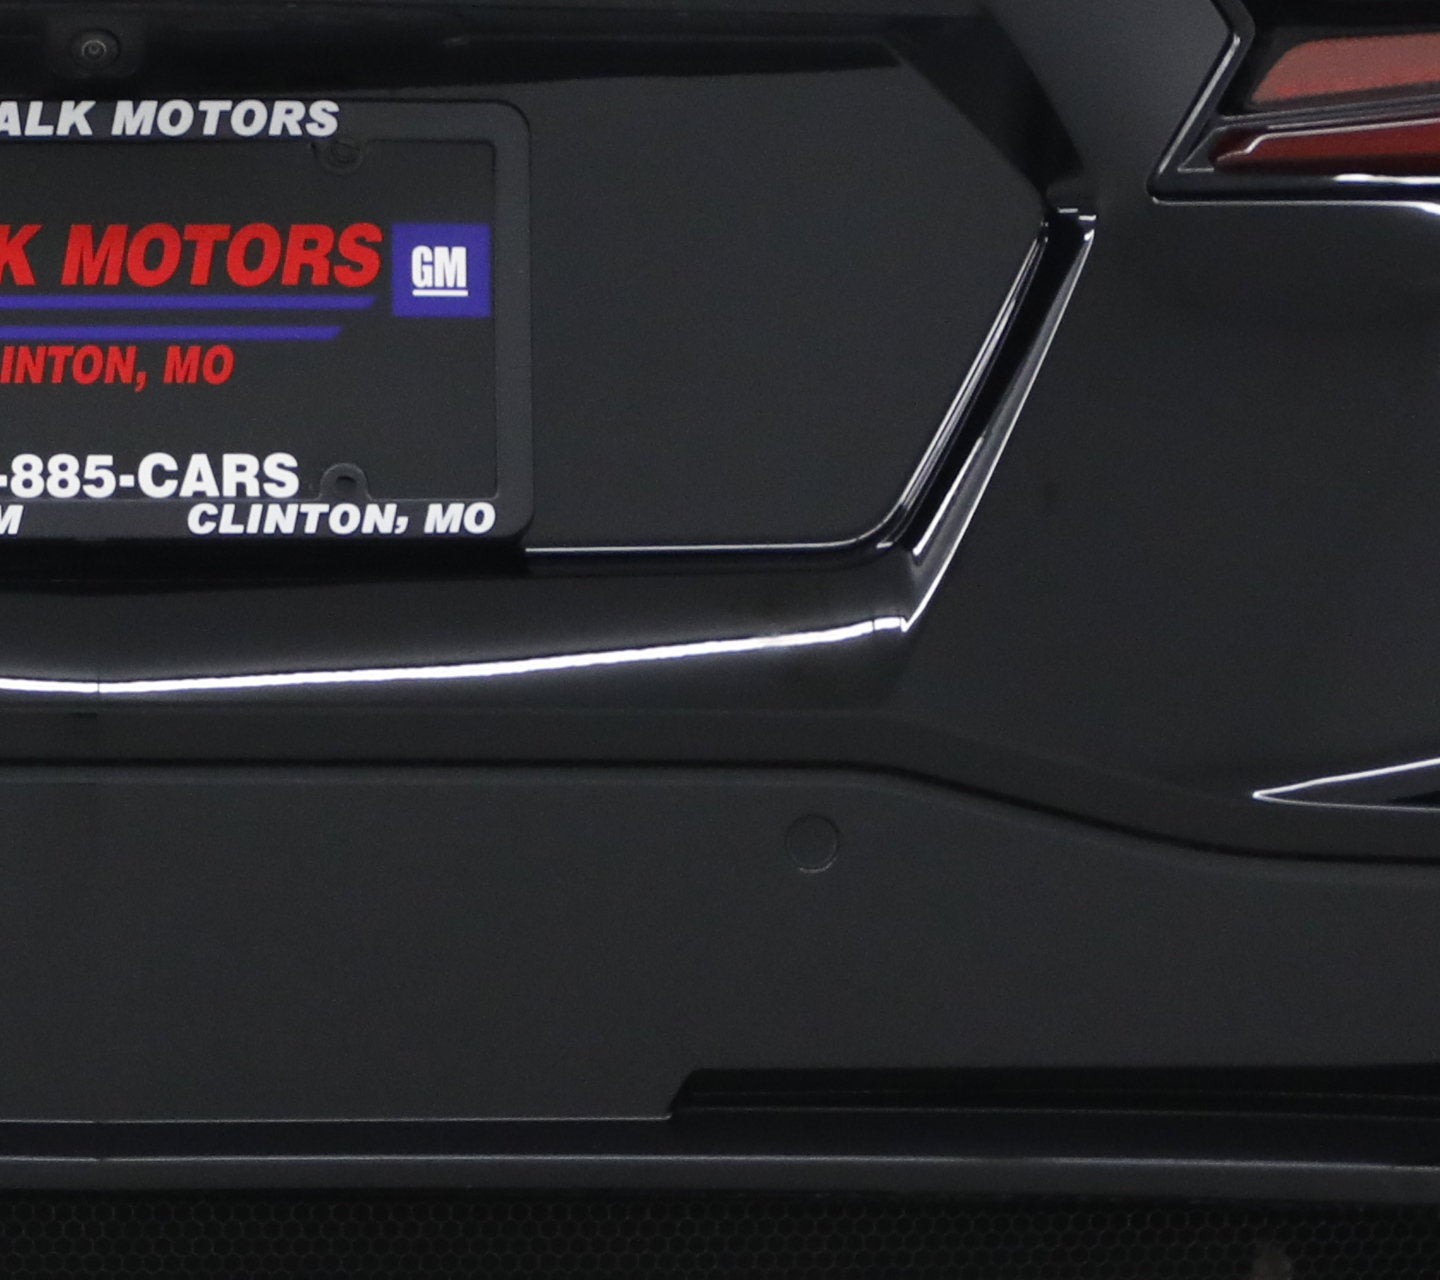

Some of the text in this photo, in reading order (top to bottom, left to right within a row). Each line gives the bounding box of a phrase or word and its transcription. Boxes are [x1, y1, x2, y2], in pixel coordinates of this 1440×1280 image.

[112, 100, 339, 136] MOTORS
[61, 222, 383, 287] MOTORS
[411, 245, 466, 288] GM
[164, 345, 234, 384] MO
[188, 502, 495, 534] CLINTON, MO
